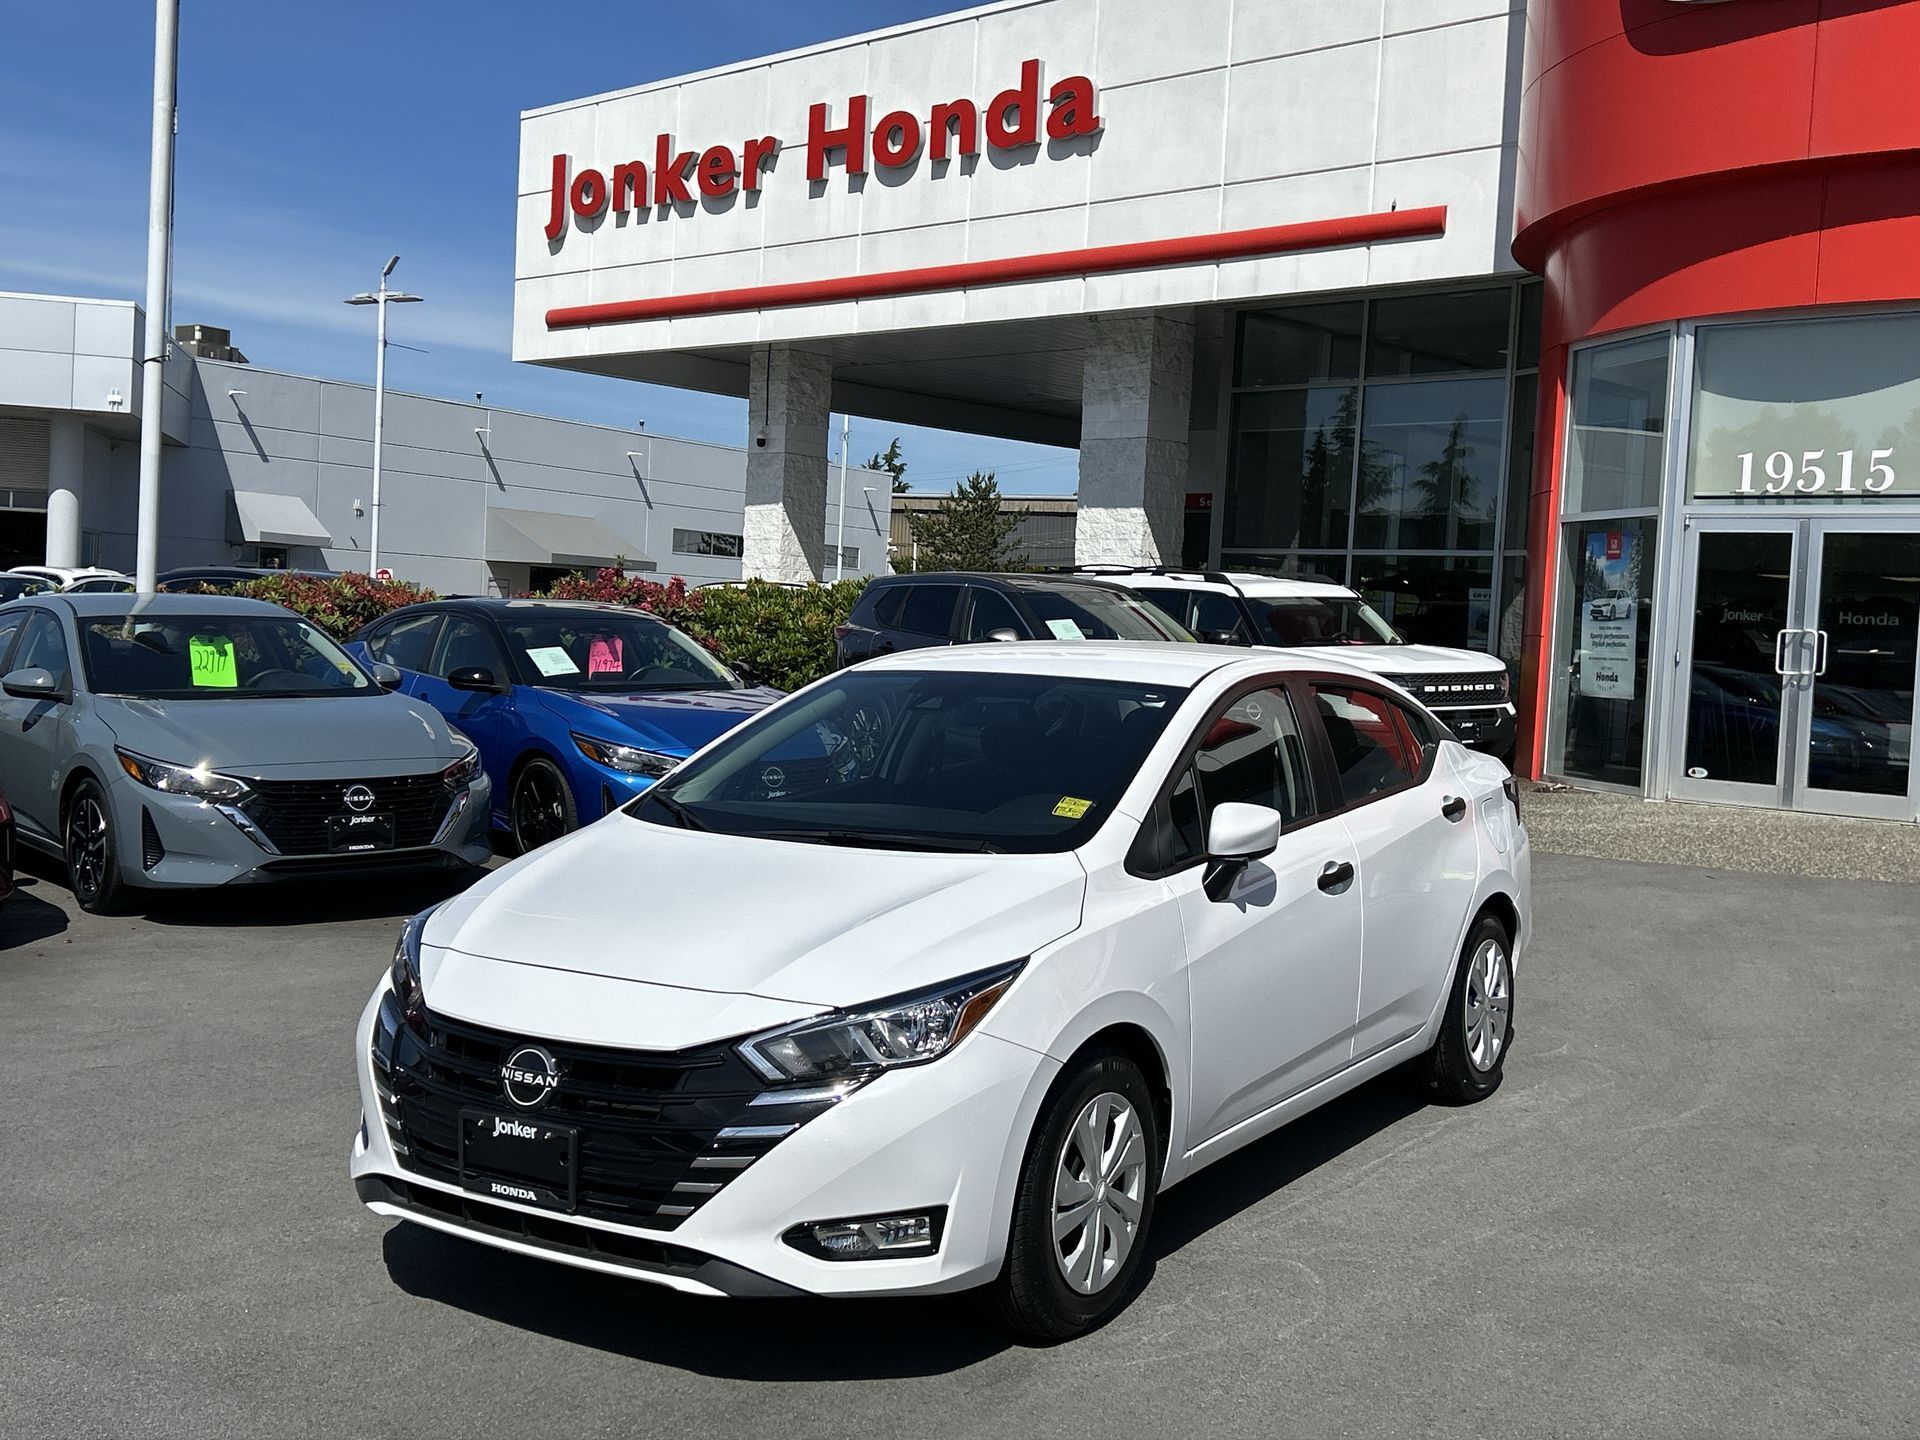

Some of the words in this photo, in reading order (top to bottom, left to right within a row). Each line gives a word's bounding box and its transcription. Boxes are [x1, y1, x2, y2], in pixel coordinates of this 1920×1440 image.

[543, 132, 781, 241] Jonker
[807, 58, 1103, 181] Honda
[1736, 447, 1895, 493] 19515
[1720, 608, 1764, 624] Jonker
[1839, 611, 1900, 626] Honda
[1596, 671, 1619, 683] Honda
[1424, 684, 1495, 692] BRONCO
[349, 815, 376, 826] Jonker
[501, 1066, 558, 1088] NISSAN
[492, 1116, 538, 1140] Jonker
[491, 1183, 538, 1201] HONDA
